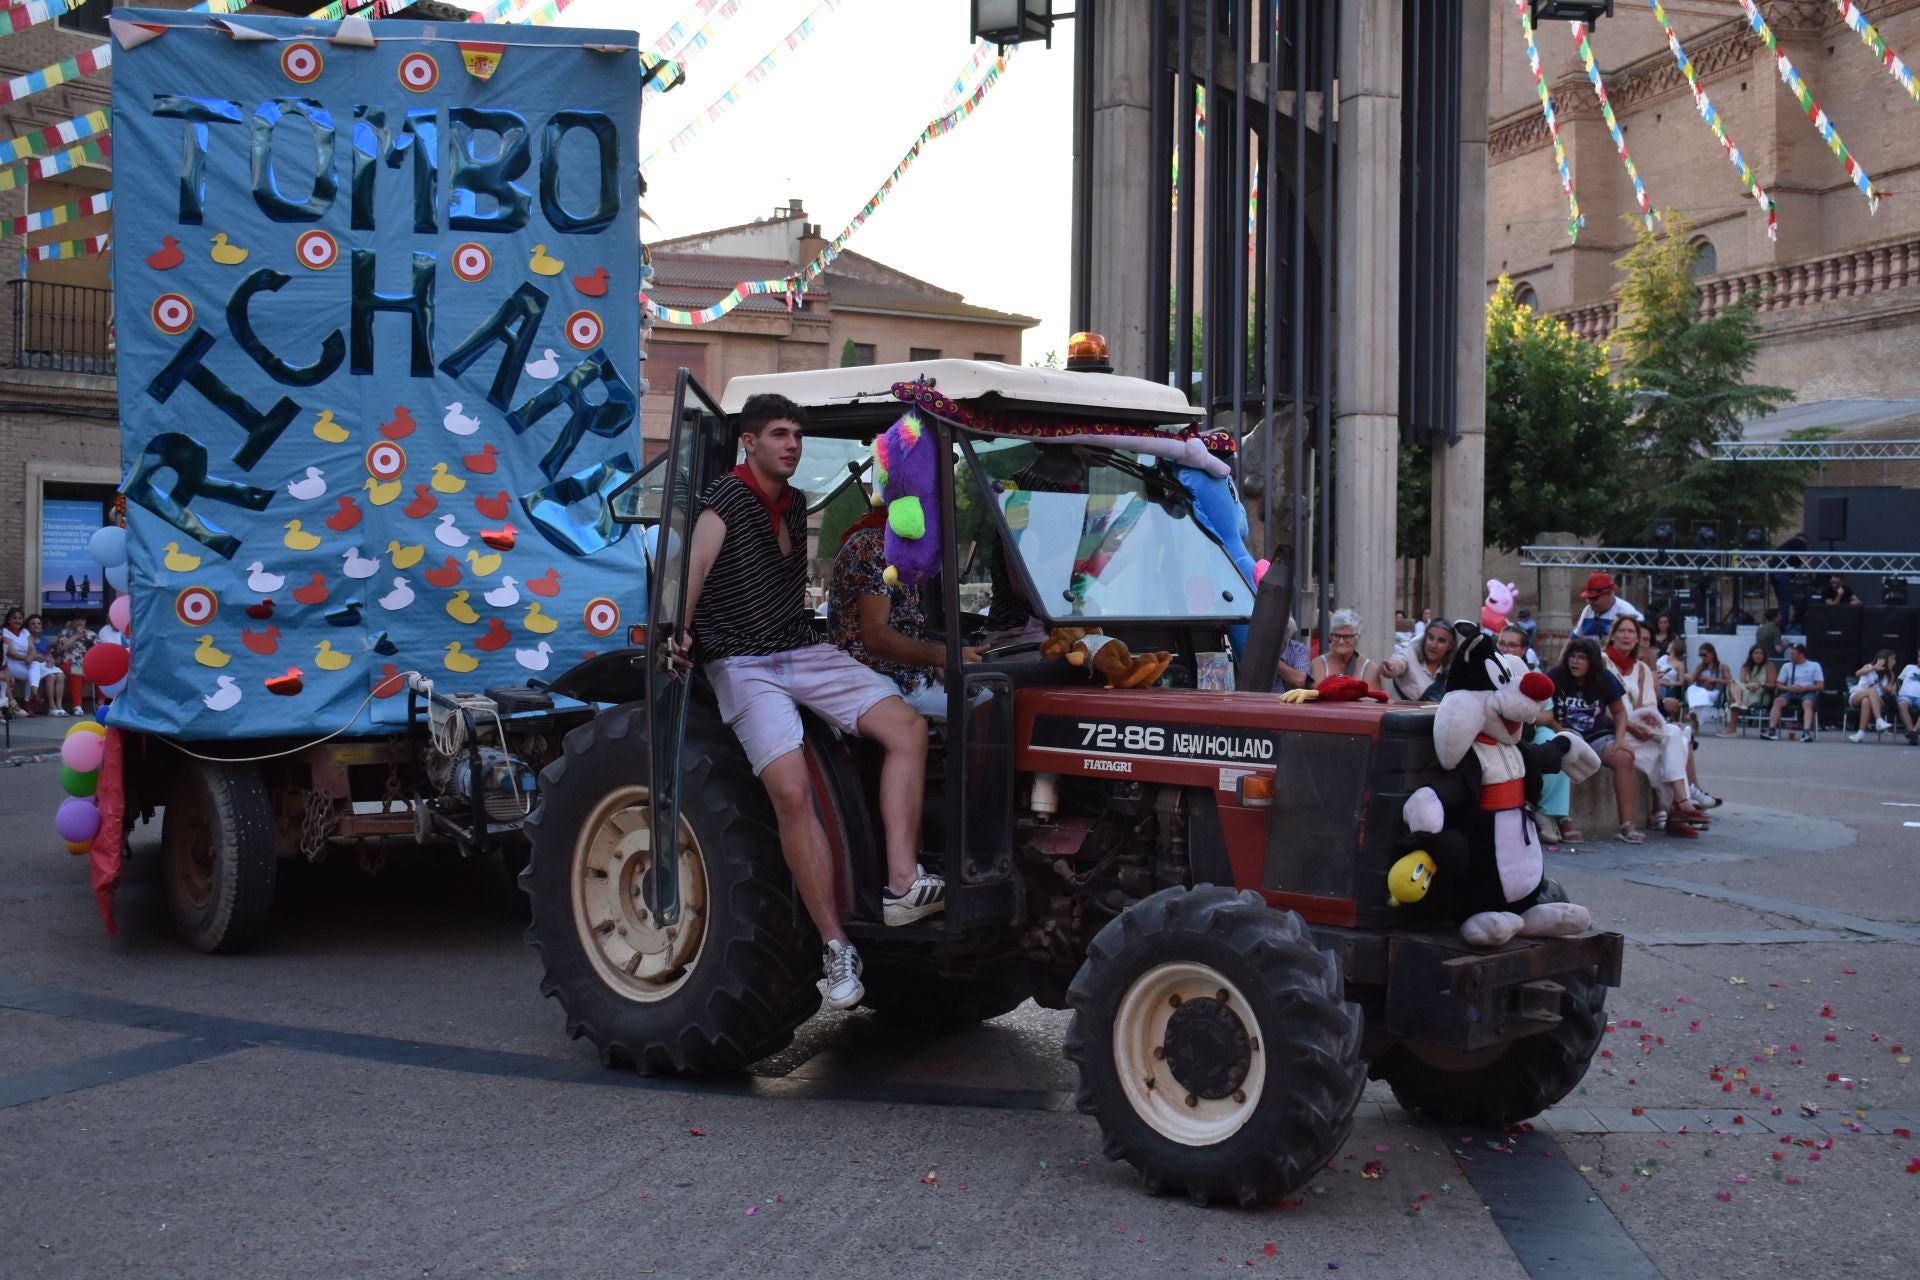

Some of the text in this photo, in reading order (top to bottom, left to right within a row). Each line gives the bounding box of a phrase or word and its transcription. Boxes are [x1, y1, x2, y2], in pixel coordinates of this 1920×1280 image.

[152, 94, 621, 234] TOMBO
[117, 248, 638, 560] RICHARD
[1083, 759, 1132, 773] FIATAGRI
[1172, 733, 1273, 760] NEW HOLLAND
